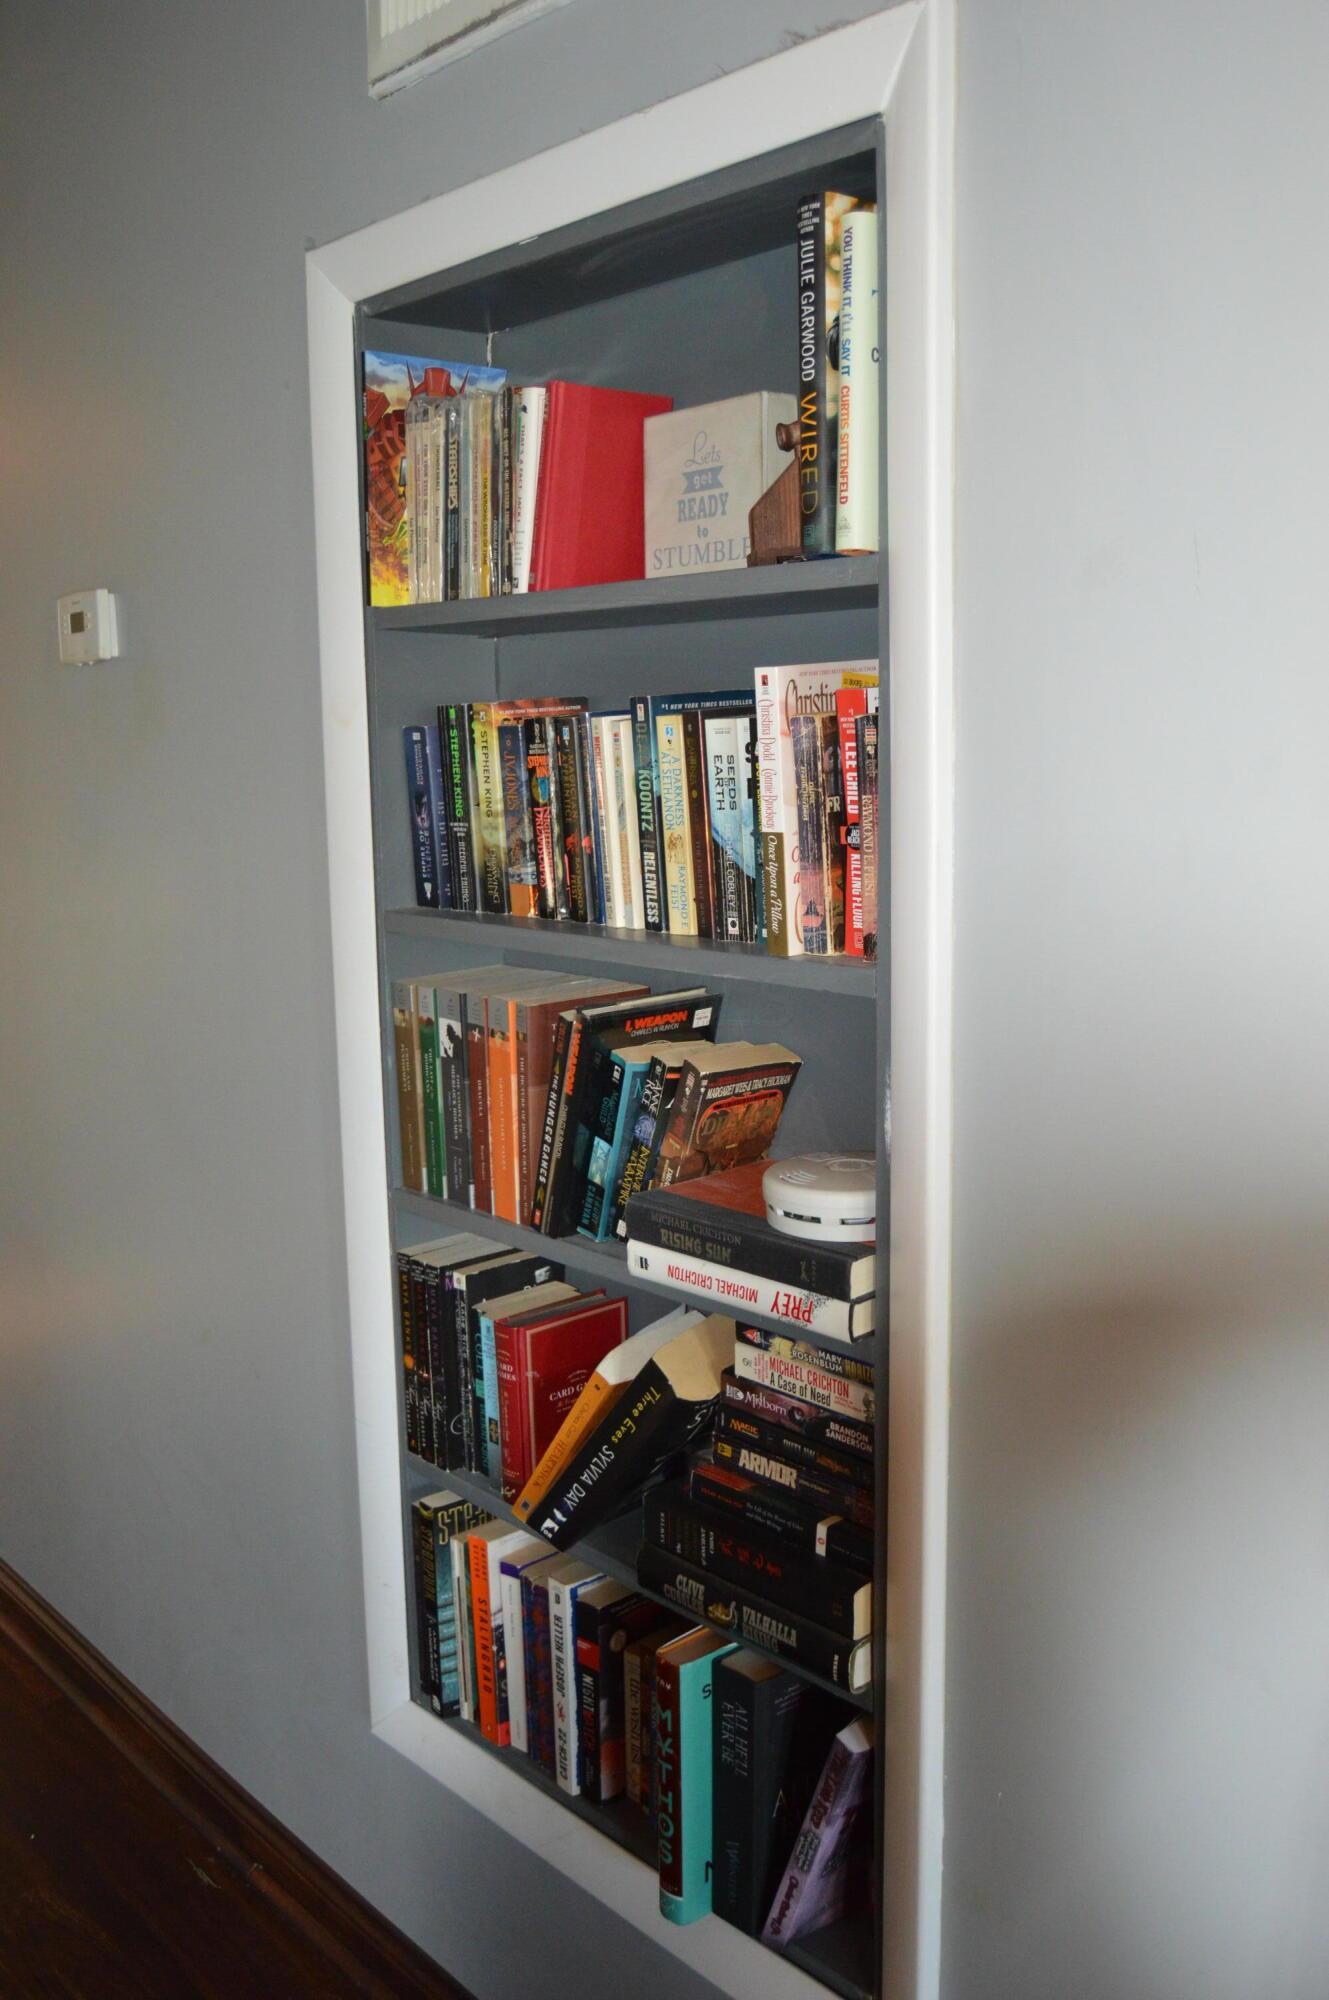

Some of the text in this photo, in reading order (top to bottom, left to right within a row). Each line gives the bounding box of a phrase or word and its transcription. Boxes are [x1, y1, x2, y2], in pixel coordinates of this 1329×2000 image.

[800, 240, 815, 287] JULIE
[840, 227, 853, 377] YOU THINK IT, I'LL SAY IT
[800, 292, 815, 382] GARWOOD
[800, 391, 818, 514] WIRED
[839, 385, 850, 504] CURTIS SITTENFELD
[448, 434, 458, 509] STARSHIPS
[694, 472, 712, 488] get
[677, 492, 729, 522] READY
[697, 525, 709, 538] to
[719, 699, 753, 707] BESTSELLER
[760, 699, 774, 735] Christina
[786, 678, 837, 732] Christin
[450, 728, 461, 785] STEPHEN
[760, 736, 776, 761] Dodd
[845, 741, 858, 768] LEE
[480, 730, 493, 817] STEPHEN KING
[505, 770, 518, 810] JONES
[661, 752, 674, 831] AT SETHANON
[672, 756, 684, 826] A DARKNESS
[713, 755, 725, 810] EARTH
[726, 755, 737, 810] SEEDS
[454, 787, 463, 816] KING
[419, 829, 425, 842] OF
[862, 794, 873, 851] RAYMOND
[638, 769, 659, 924] KOONTZ RELENTLESS
[678, 865, 688, 919] RAYMOND
[726, 869, 736, 908] COBLEY
[766, 835, 783, 934] Once Upon a Pillow
[851, 853, 863, 893] KILLING
[671, 884, 679, 909] FEIST
[634, 1010, 689, 1029] WEAPON
[565, 1031, 581, 1095] WEAPON
[641, 1079, 654, 1105] RICE
[648, 1079, 662, 1113] ANNE
[707, 1084, 735, 1100] MARGARET
[544, 1091, 557, 1141] HUNGER
[538, 1144, 550, 1183] GAMES
[618, 1160, 635, 1206] VAMPIRE
[632, 1145, 651, 1193] INTERVIE
[660, 1228, 703, 1254] RISING
[705, 1241, 731, 1263] SUN
[401, 1273, 411, 1349] MAYA BANKS
[667, 1264, 813, 1324] PREY MICHAEL CRICHTON
[792, 1350, 843, 1373] ROSENBLUM
[818, 1350, 842, 1363] MARY
[549, 1386, 574, 1401] CARD
[769, 1358, 804, 1383] MICHAEL
[807, 1369, 849, 1399] CRICHTON
[769, 1372, 775, 1385] A
[778, 1375, 797, 1393] Case
[799, 1384, 808, 1399] of
[810, 1387, 831, 1407] Need
[632, 1386, 660, 1416] Three
[729, 1418, 760, 1435] MAGIC
[825, 1429, 873, 1452] SANDERSON
[830, 1421, 869, 1442] BRANDON
[580, 1444, 614, 1485] SYLVIA
[739, 1448, 798, 1489] ARMOR
[563, 1482, 587, 1511] DAY
[675, 1573, 705, 1603] CLIVE
[478, 1597, 492, 1694] STALINGRAD
[742, 1604, 797, 1648] VALHALLA
[553, 1615, 568, 1780] JOSEPH HELLER CATCH-22
[581, 1673, 595, 1713] NIGHT
[721, 1702, 734, 1767] EVER BE
[735, 1702, 748, 1732] ALL
